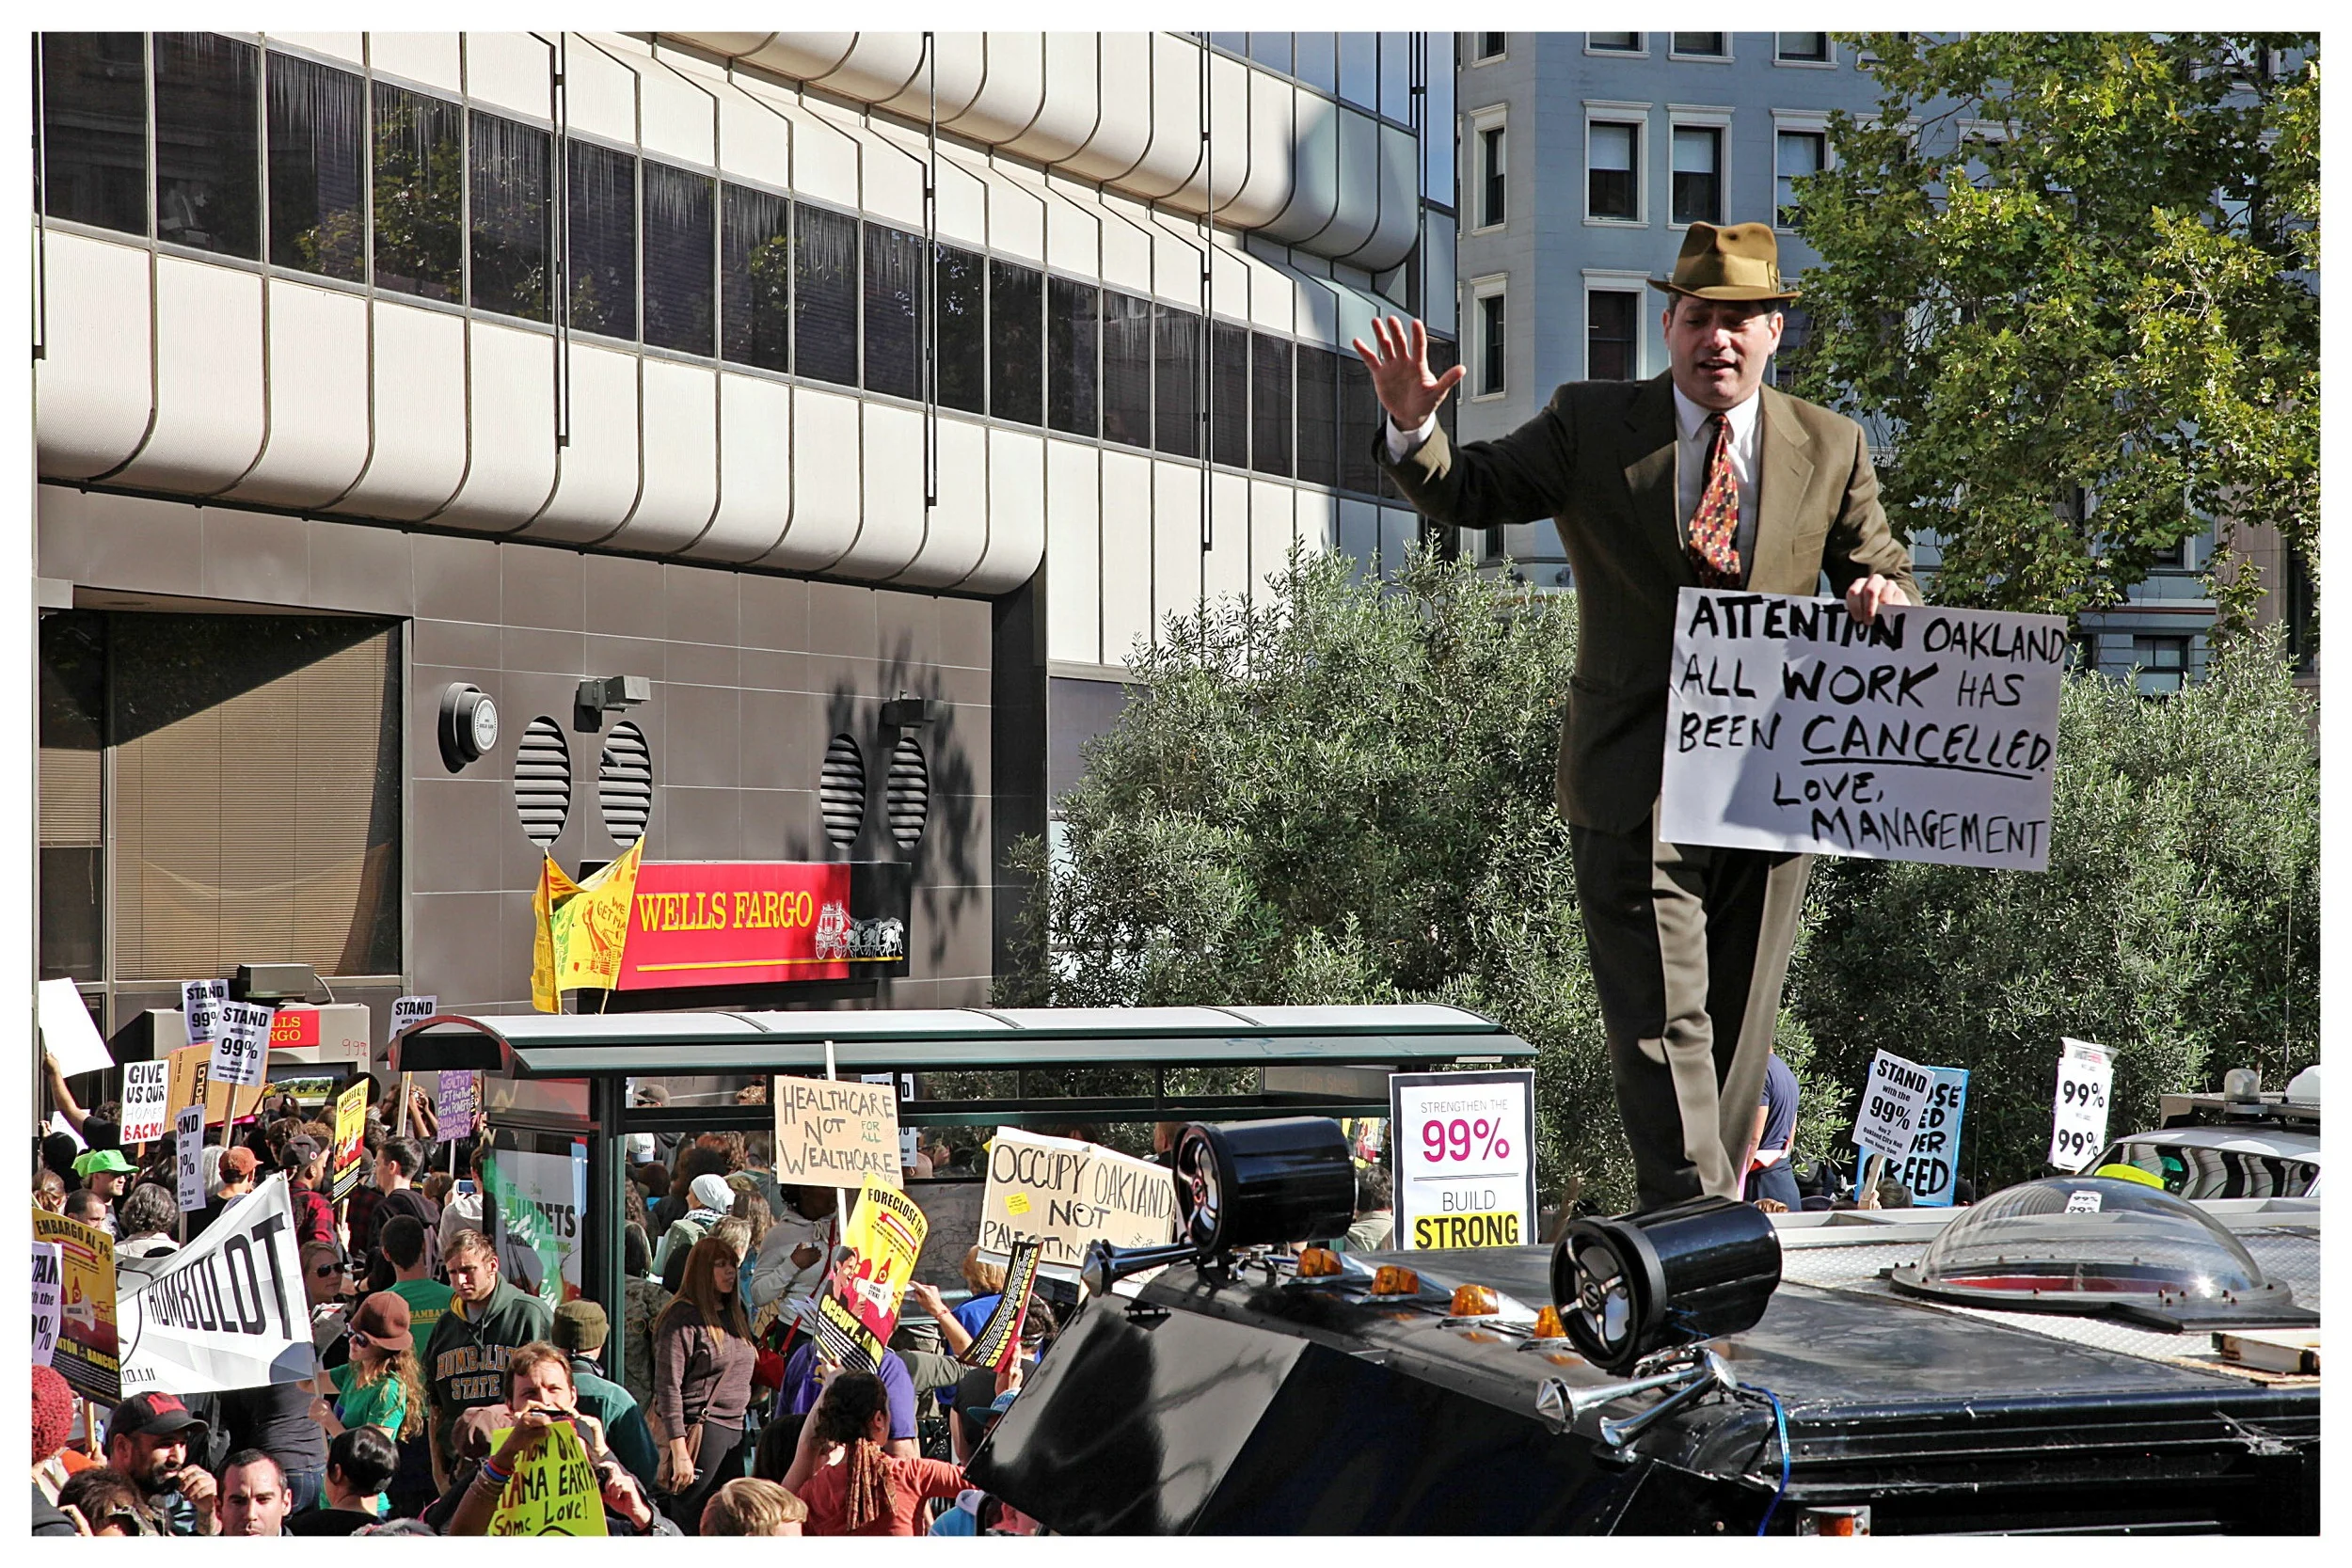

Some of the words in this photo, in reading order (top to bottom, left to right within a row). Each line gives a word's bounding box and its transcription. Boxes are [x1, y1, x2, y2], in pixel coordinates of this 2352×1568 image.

[1689, 594, 1906, 651] ATTENTION
[1923, 617, 2066, 665] OAKLAND
[1680, 653, 1756, 699] ALL
[1783, 660, 1939, 707] WORK
[1958, 671, 2025, 707] HAS
[1679, 712, 1781, 752] BEEN
[1772, 771, 1884, 806] LOVE,
[1812, 806, 2046, 858] MANAGEMENT
[596, 901, 613, 922] GET
[637, 891, 727, 932] WELLS
[733, 890, 814, 929] FARGO
[186, 986, 224, 1000] STAND
[223, 1006, 267, 1027] STAND
[272, 1017, 301, 1028] LLS
[395, 1002, 433, 1015] STAND
[220, 1037, 258, 1059] 99%
[271, 1030, 301, 1041] RGO
[128, 1063, 165, 1085] GIVE
[1877, 1058, 1928, 1094] STAND
[126, 1085, 143, 1104] US
[145, 1085, 165, 1101] OUR
[783, 1085, 895, 1125] HEALTHCARE
[1421, 1100, 1486, 1114] STRENGTHEN
[1490, 1099, 1508, 1111] THE
[1882, 1085, 1897, 1098] with
[1898, 1089, 1911, 1102] the
[2063, 1080, 2105, 1108] 99%
[125, 1106, 164, 1122] HOMES
[1869, 1096, 1911, 1131] 99%
[123, 1122, 163, 1141] BACK!
[804, 1116, 846, 1146] NOT
[861, 1120, 880, 1132] FOR
[862, 1132, 882, 1143] ALL
[1422, 1117, 1510, 1163] 99%
[1863, 1126, 1883, 1141] Oakland
[1882, 1134, 1894, 1147] City
[1893, 1139, 1903, 1149] Hall
[2058, 1129, 2099, 1157] 99%
[779, 1139, 899, 1176] WEALTHCARE
[862, 1172, 882, 1181] FR
[992, 1144, 1090, 1195] OCCUPY
[1094, 1163, 1172, 1219] OAKLAND
[867, 1188, 917, 1226] FORECLOSE
[1049, 1199, 1111, 1229] NOT
[1442, 1189, 1496, 1212] BUILD
[36, 1220, 85, 1242] EMBARGO
[86, 1233, 96, 1249] AL
[99, 1241, 111, 1262] 1%
[1415, 1213, 1518, 1249] STRONG
[148, 1212, 293, 1339] HUMBOLDT
[1015, 1247, 1039, 1309] OCCUPY
[40, 1292, 55, 1306] the
[820, 1294, 856, 1338] OCCUPY
[985, 1320, 1016, 1368] BANKS
[87, 1348, 119, 1372] BANCOS
[452, 1374, 500, 1400] STATE
[559, 1461, 597, 1497] EARTH
[544, 1496, 588, 1526] Love!
